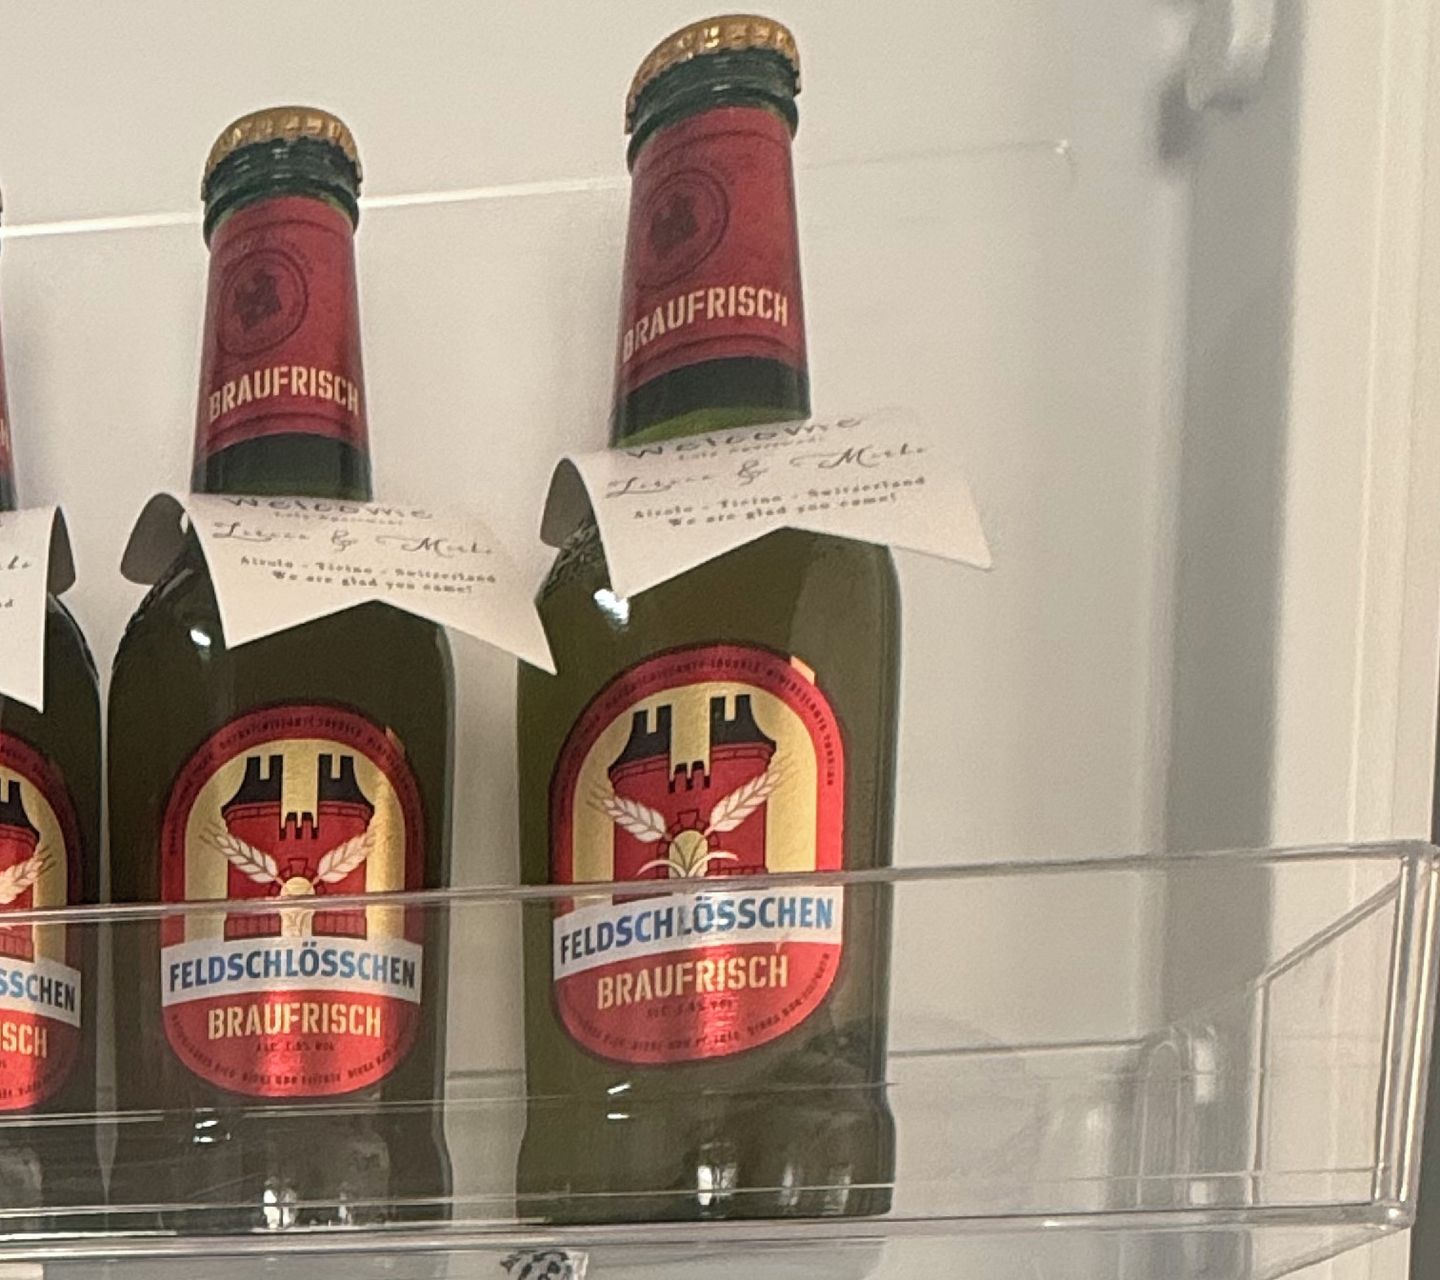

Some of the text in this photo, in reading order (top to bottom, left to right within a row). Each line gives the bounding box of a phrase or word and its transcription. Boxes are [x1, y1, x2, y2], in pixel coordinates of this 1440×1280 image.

[622, 285, 789, 363] BRAUFRISCH
[209, 365, 359, 423] BRAUFRISCH
[559, 895, 834, 965] FELDSCHLÖSSCHEN
[169, 942, 417, 993] FELDSCHLÖSSCHEN
[596, 954, 789, 1010] BRAUFRISCH
[207, 1002, 382, 1041] BRAUFRISCH
